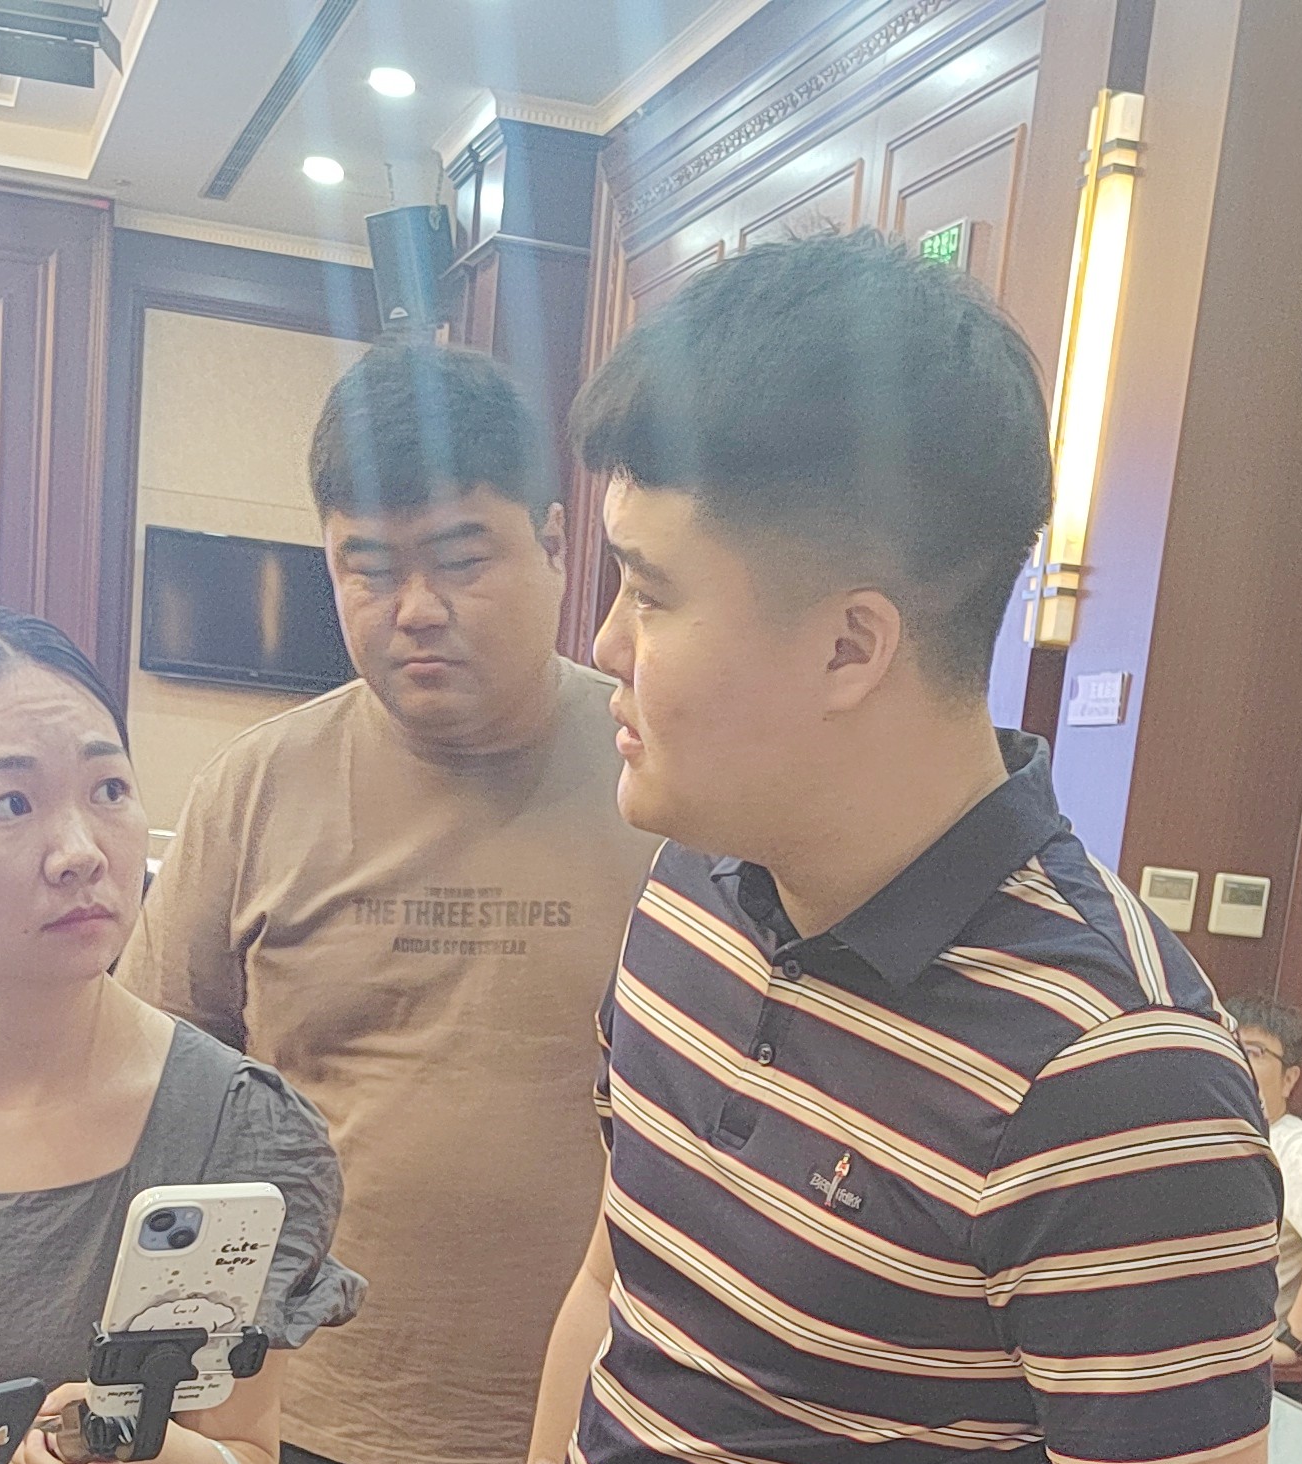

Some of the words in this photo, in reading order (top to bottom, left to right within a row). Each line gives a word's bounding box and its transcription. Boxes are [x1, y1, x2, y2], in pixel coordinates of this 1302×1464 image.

[353, 899, 396, 926] THE
[403, 899, 474, 928] THREE
[478, 900, 573, 928] STRIPES
[392, 937, 441, 955] ADIDAS
